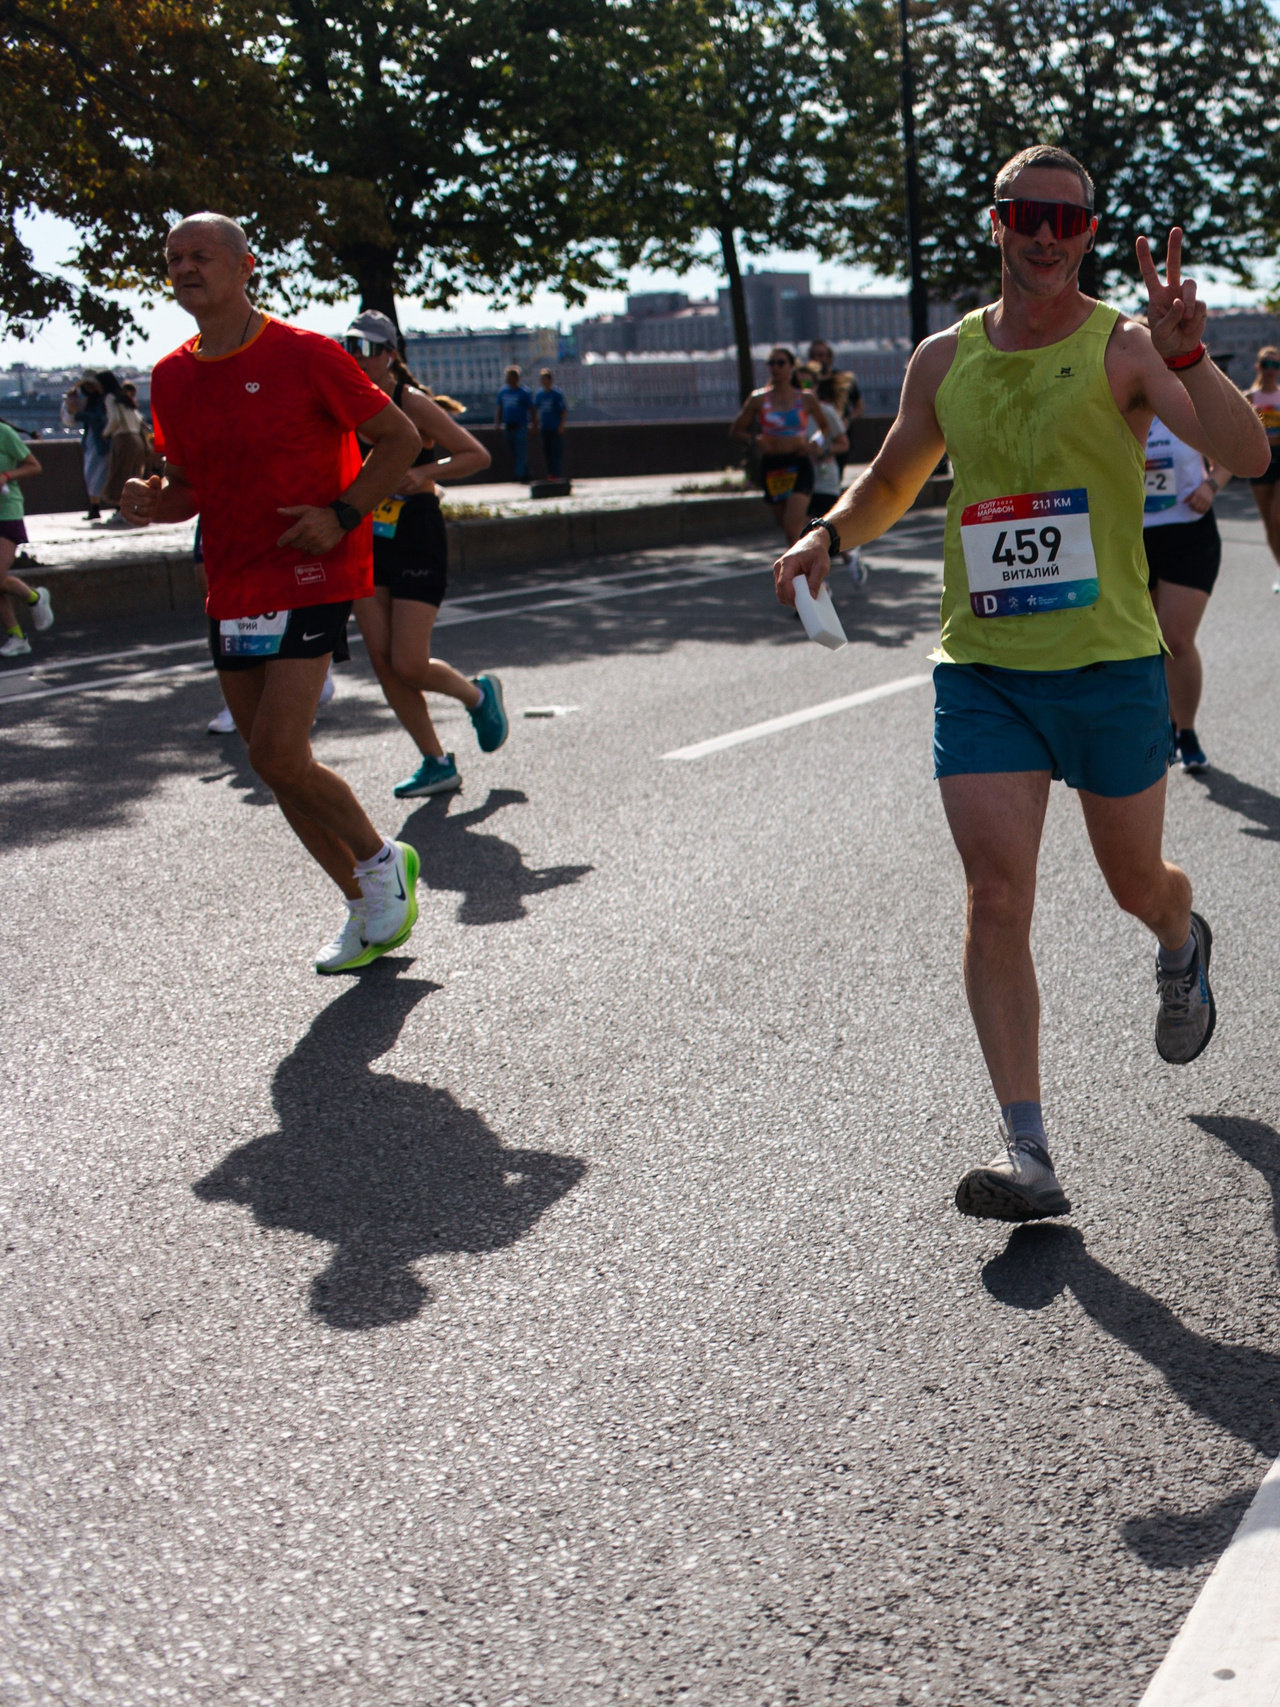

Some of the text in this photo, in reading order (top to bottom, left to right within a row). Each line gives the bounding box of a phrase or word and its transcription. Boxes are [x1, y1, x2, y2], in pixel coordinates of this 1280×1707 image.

[977, 501, 996, 510] ПОЛУ
[977, 505, 1014, 517] МАРАФОН
[1032, 497, 1071, 510] 21,1 КМ
[991, 525, 1062, 567] 459
[1002, 563, 1060, 582] ВИТАЛИЙ
[983, 594, 998, 614] D
